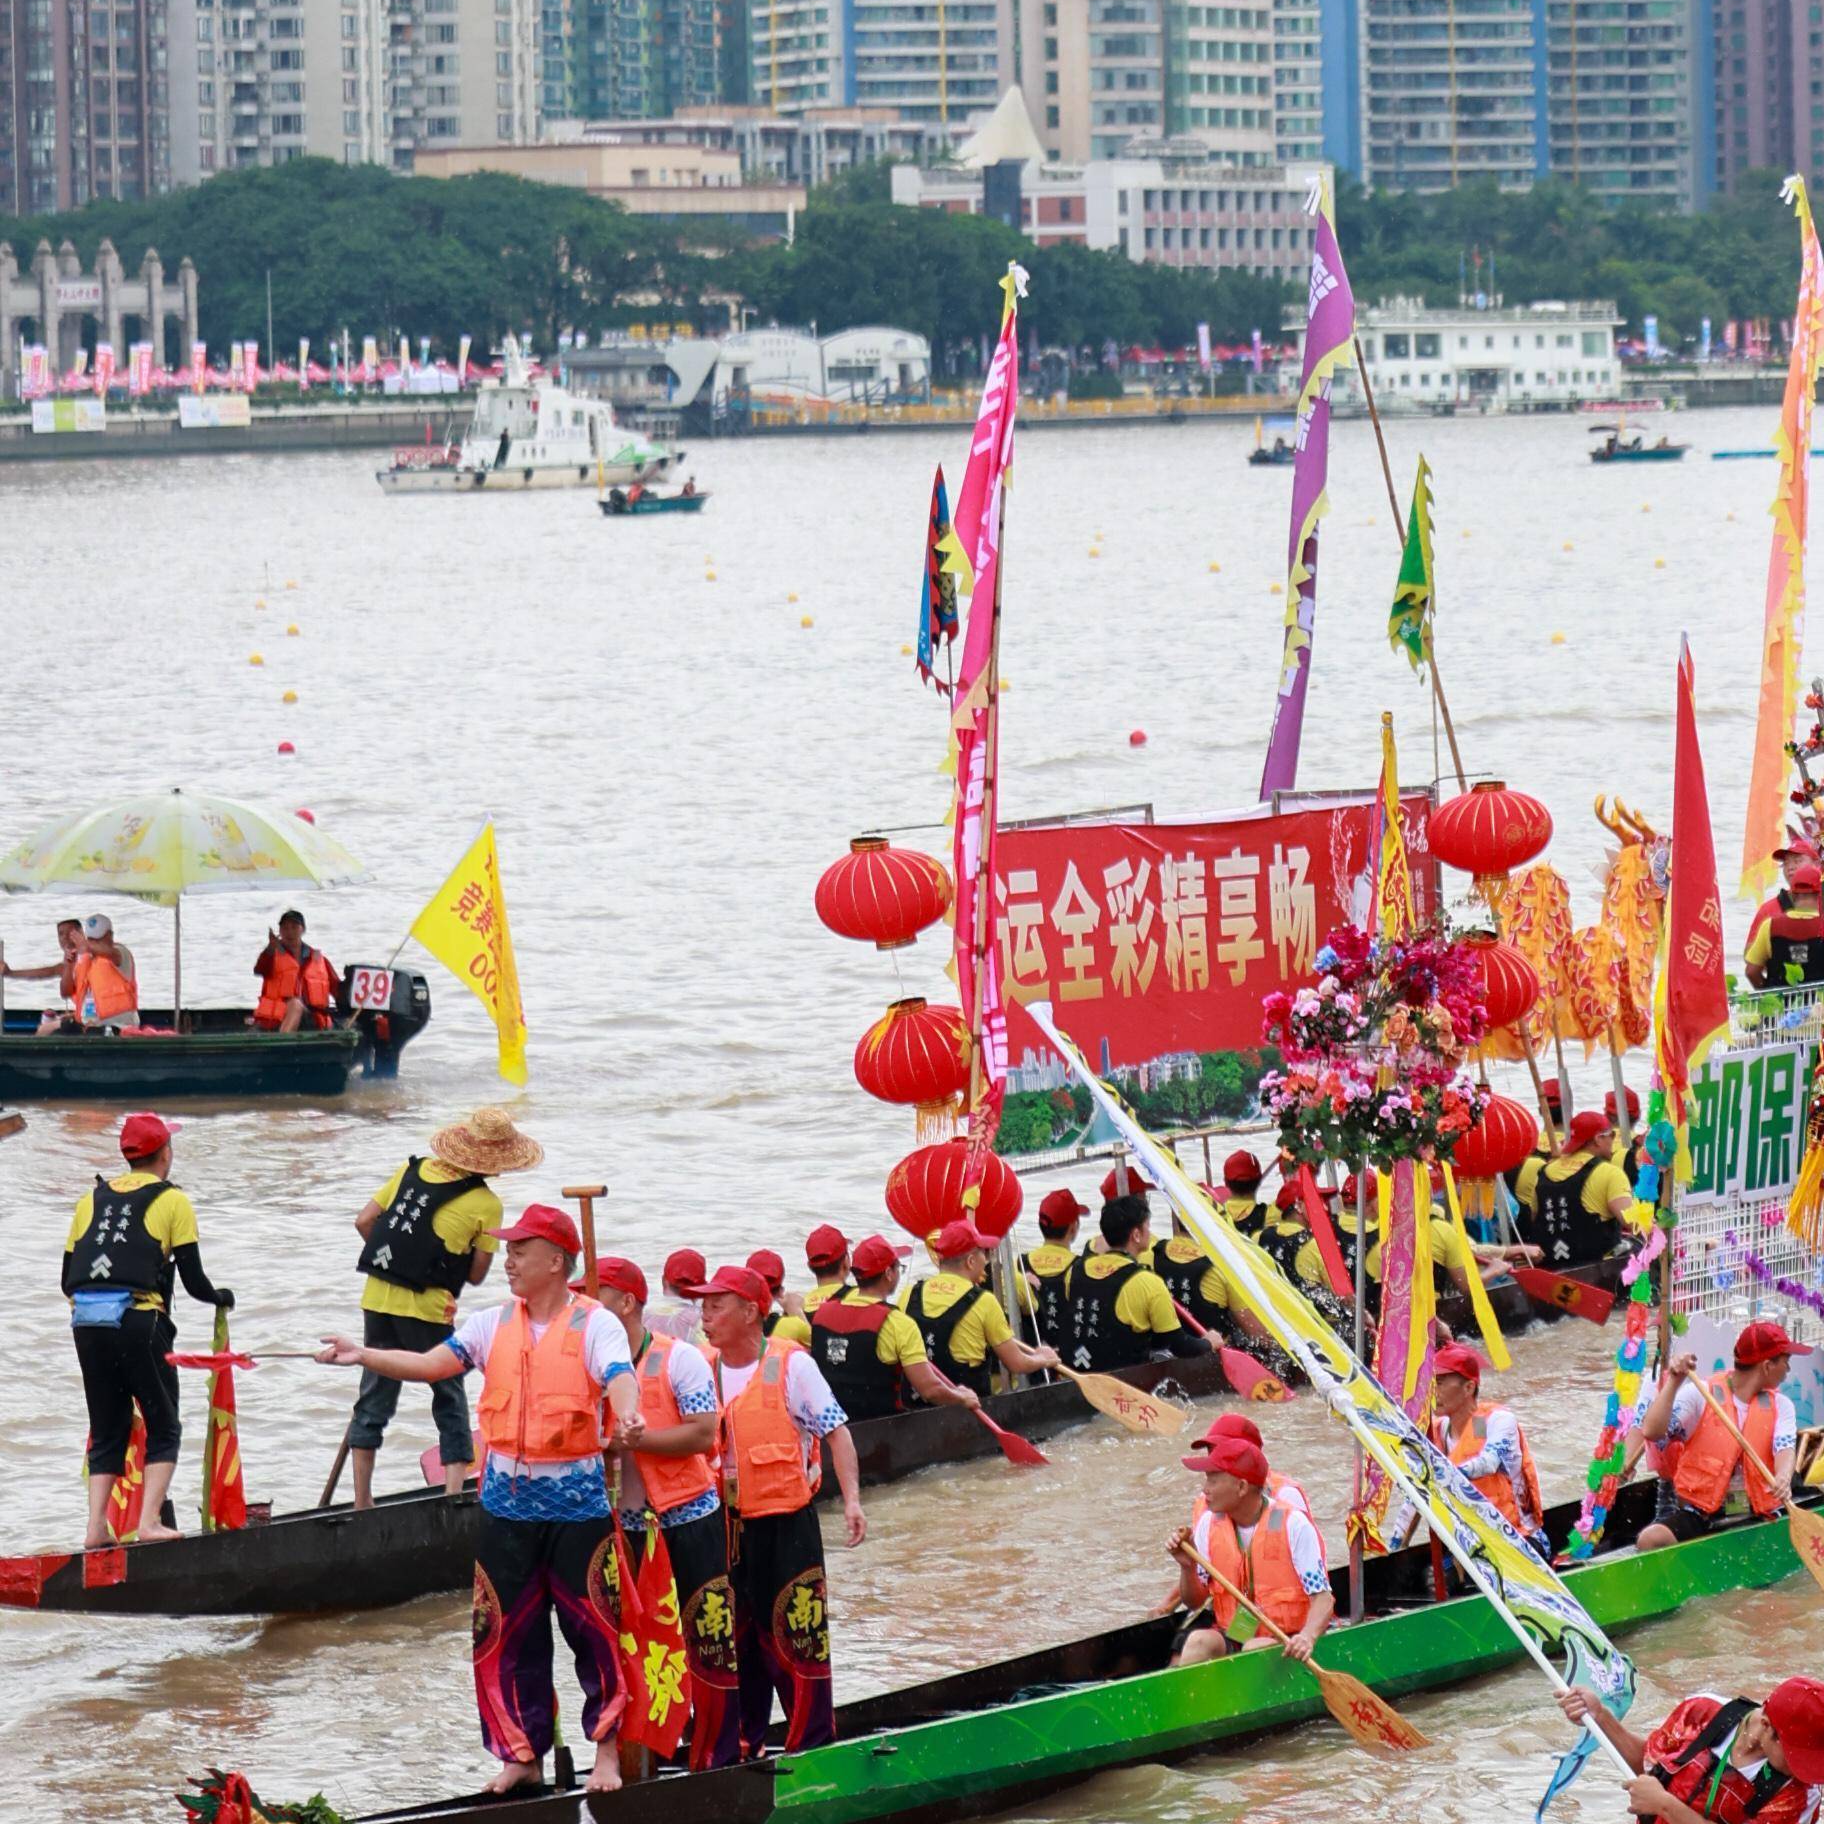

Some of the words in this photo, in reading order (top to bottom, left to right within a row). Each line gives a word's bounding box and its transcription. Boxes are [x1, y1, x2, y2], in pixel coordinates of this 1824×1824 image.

[354, 971, 391, 1006] 39
[1688, 1051, 1800, 1196] 邮保
[699, 1644, 723, 1657] Nan
[792, 1636, 813, 1650] Nan
